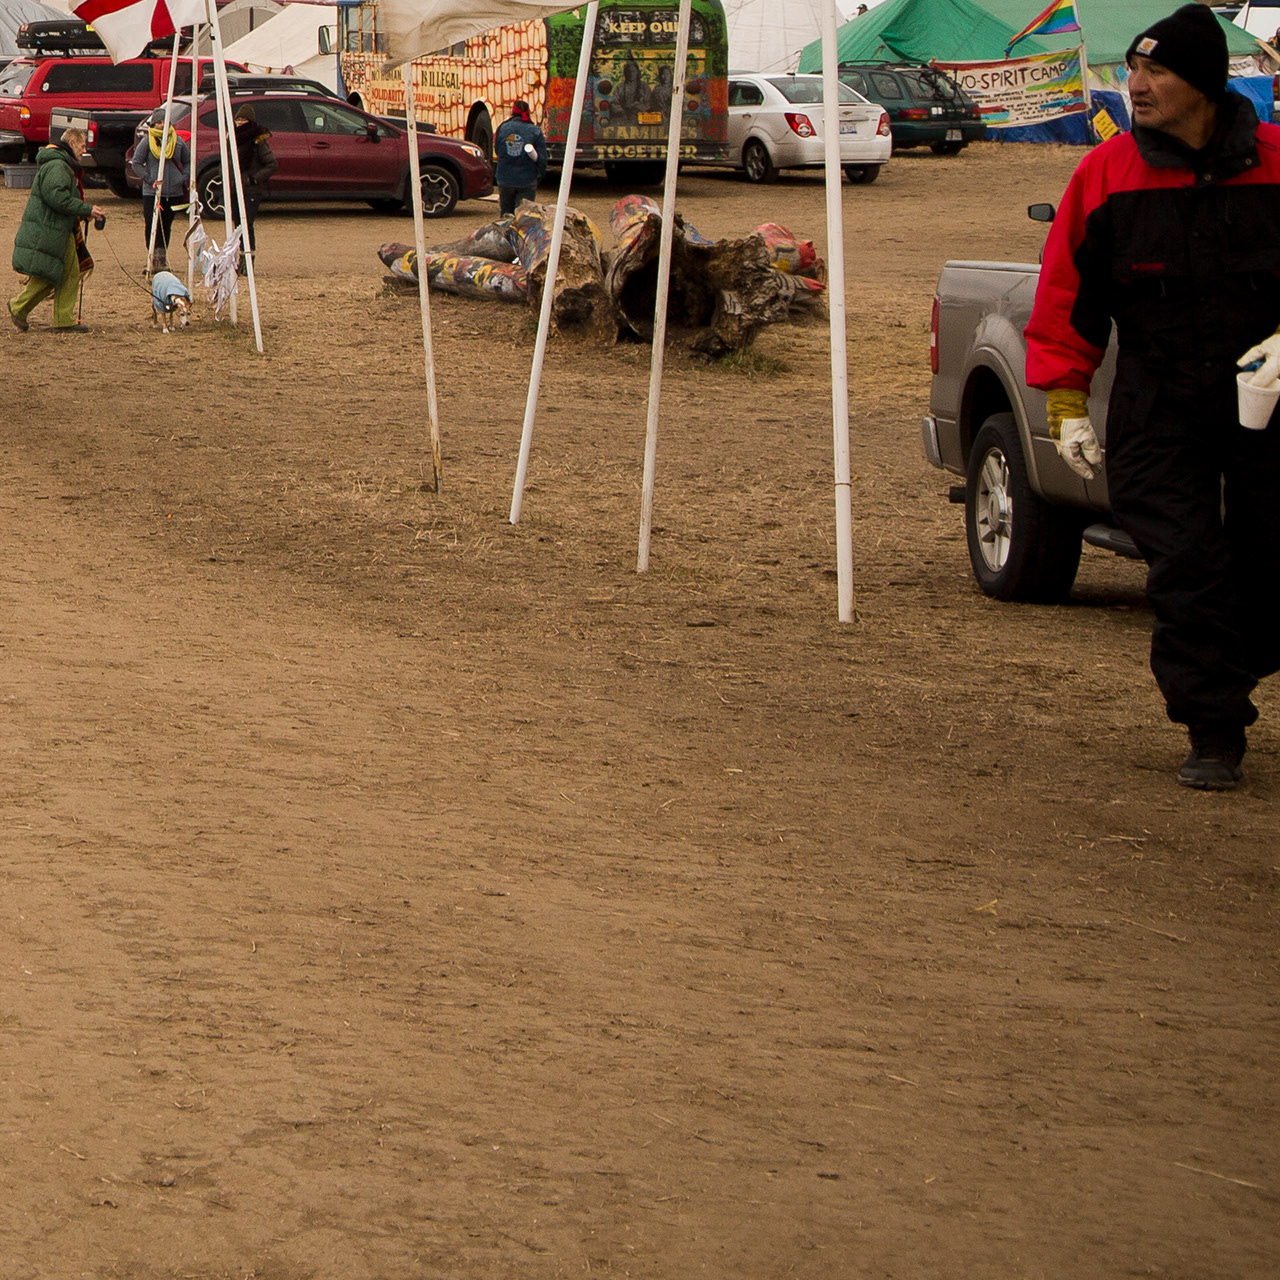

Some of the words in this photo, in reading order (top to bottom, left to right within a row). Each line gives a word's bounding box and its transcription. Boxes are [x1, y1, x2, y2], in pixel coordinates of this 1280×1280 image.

[609, 22, 646, 34] KEEP
[1030, 62, 1068, 83] CAMP
[371, 88, 405, 102] SOLIDARITY
